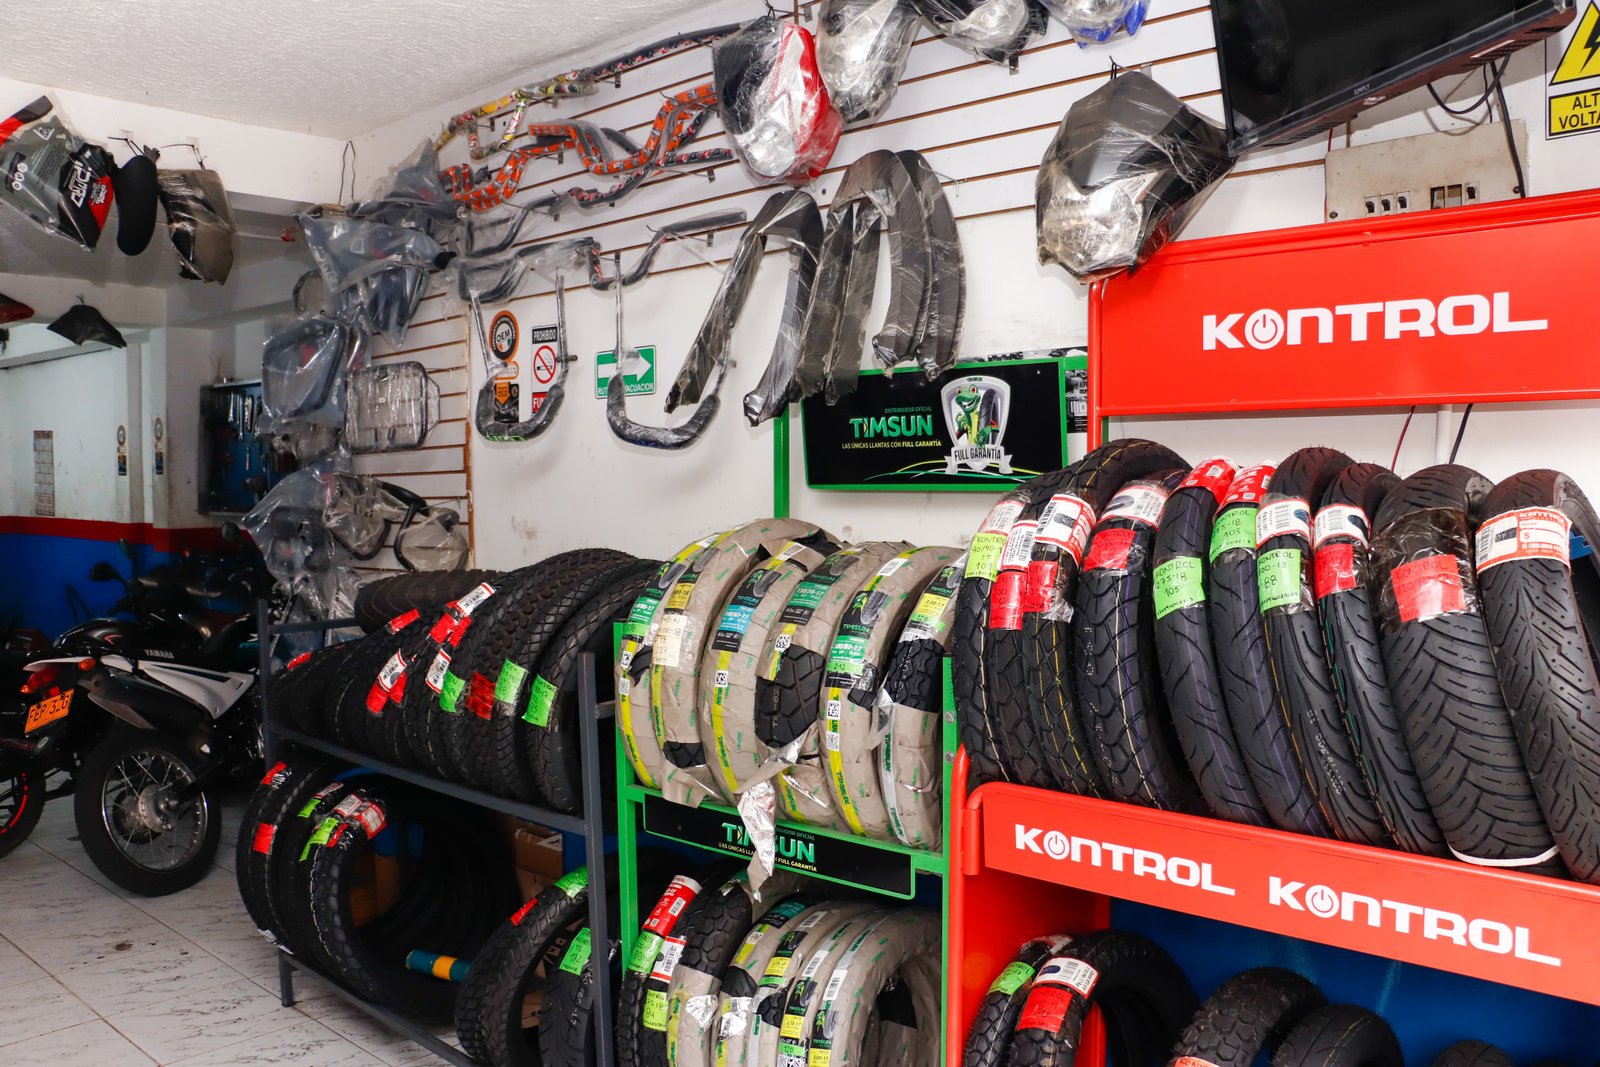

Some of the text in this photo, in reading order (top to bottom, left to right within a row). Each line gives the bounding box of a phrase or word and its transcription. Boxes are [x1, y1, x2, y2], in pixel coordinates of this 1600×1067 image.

[1572, 92, 1600, 110] ALT
[1203, 292, 1548, 351] KONTROL
[497, 329, 511, 342] OEM
[533, 328, 557, 342] PROHIBIDO
[597, 382, 654, 396] RUT ACUACION
[849, 414, 933, 438] TIMSUN
[869, 441, 890, 449] LLANTAS
[915, 438, 942, 448] GARANTÍA
[954, 446, 1001, 461] FULL GARANTÍA
[975, 535, 1006, 545] KONTRO
[1258, 551, 1294, 565] KONTROL
[1155, 560, 1195, 578] KONTROL
[843, 622, 870, 633] TIMSUN
[144, 648, 175, 659] YAMAHA
[796, 831, 816, 842] OFICIAL
[777, 857, 818, 873] FULL GARANTÍA
[1015, 824, 1236, 897] KONTROL
[1269, 876, 1562, 968] KONTROL
